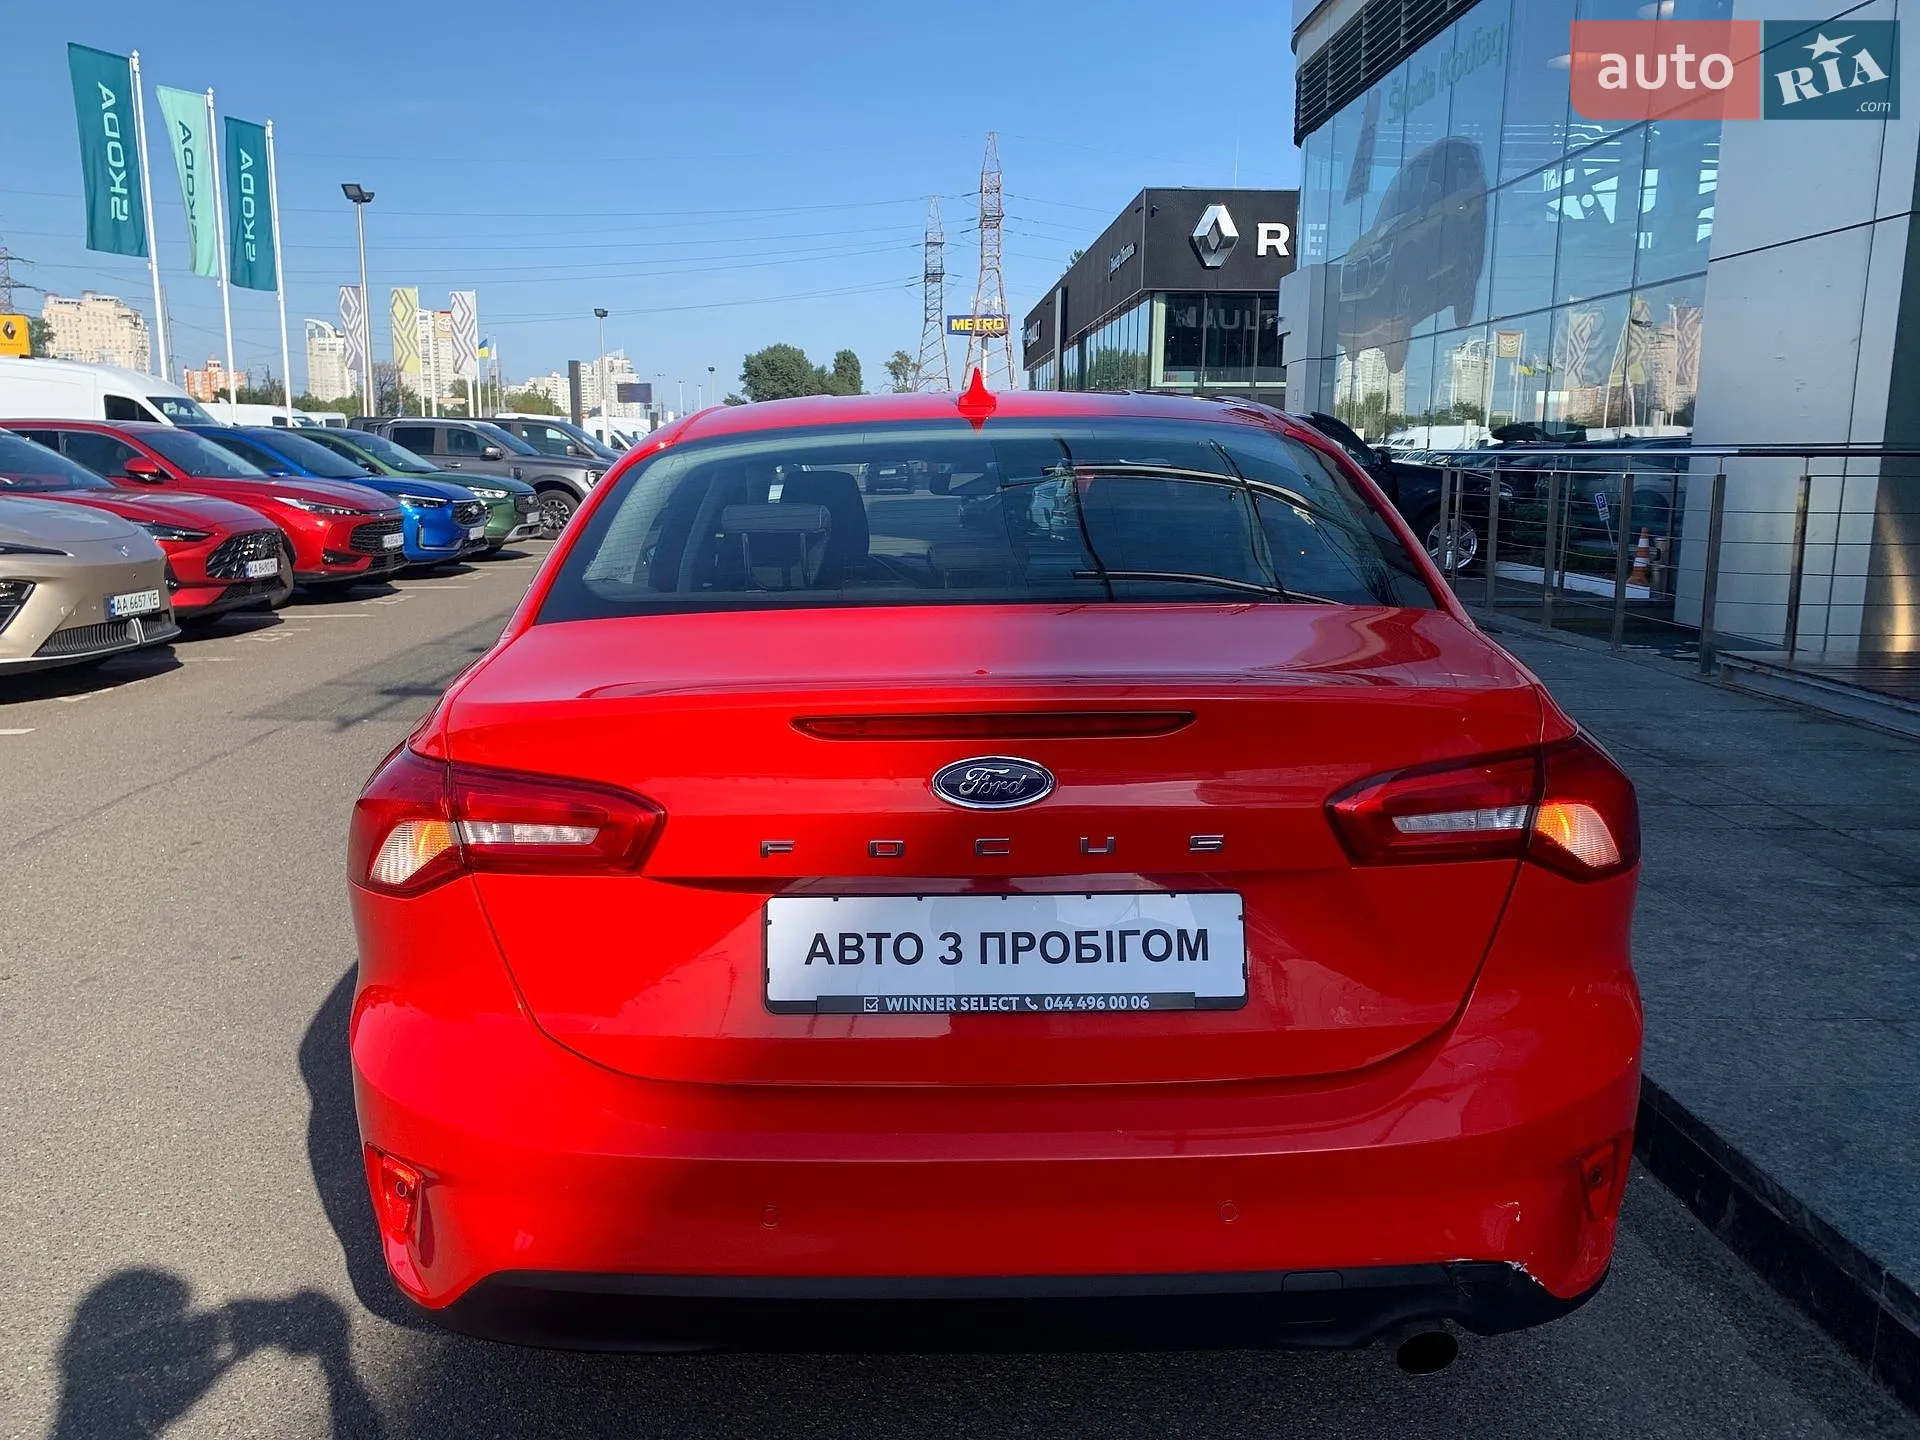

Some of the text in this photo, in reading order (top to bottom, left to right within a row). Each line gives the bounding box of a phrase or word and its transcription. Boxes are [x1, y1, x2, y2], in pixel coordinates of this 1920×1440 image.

[951, 318, 1005, 331] METRO
[958, 766, 1026, 796] Ford
[760, 834, 1225, 857] FOCUS
[804, 931, 925, 967] АВТО
[979, 927, 1210, 965] ПРОБІГОМ
[885, 995, 1150, 1012] WINNER SELECT 044 496 00 06
